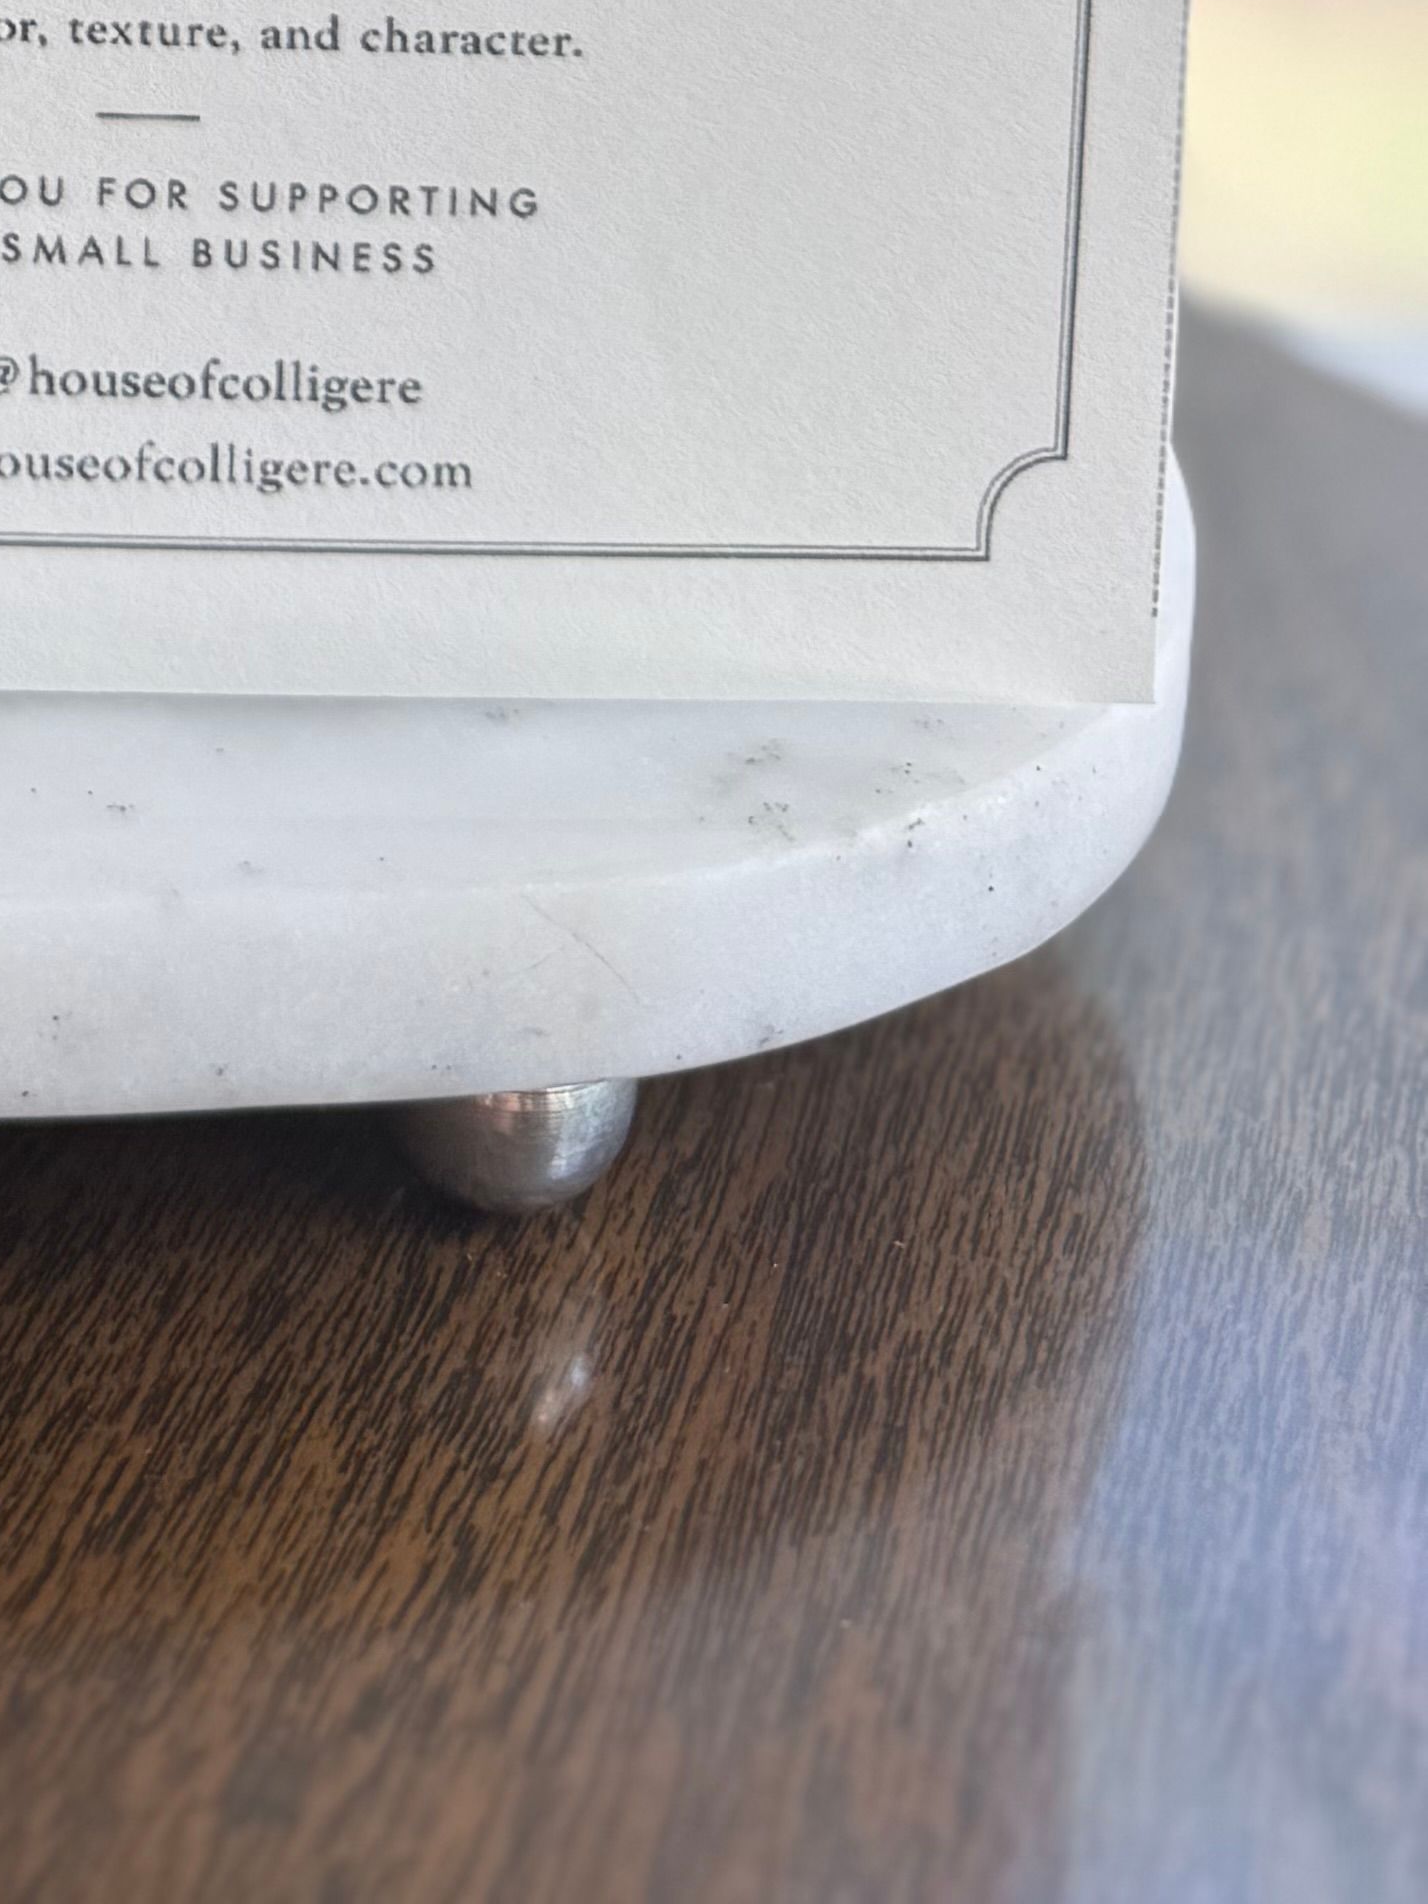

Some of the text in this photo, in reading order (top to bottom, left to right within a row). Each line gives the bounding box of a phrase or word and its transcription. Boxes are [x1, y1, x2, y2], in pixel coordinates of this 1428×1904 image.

[69, 18, 241, 55] texture,
[260, 13, 340, 52] and
[359, 16, 583, 58] character.
[98, 177, 188, 211] FOR
[219, 181, 538, 220] SUPPORTING
[2, 232, 160, 268] SMALL
[192, 238, 435, 275] BUSINESS
